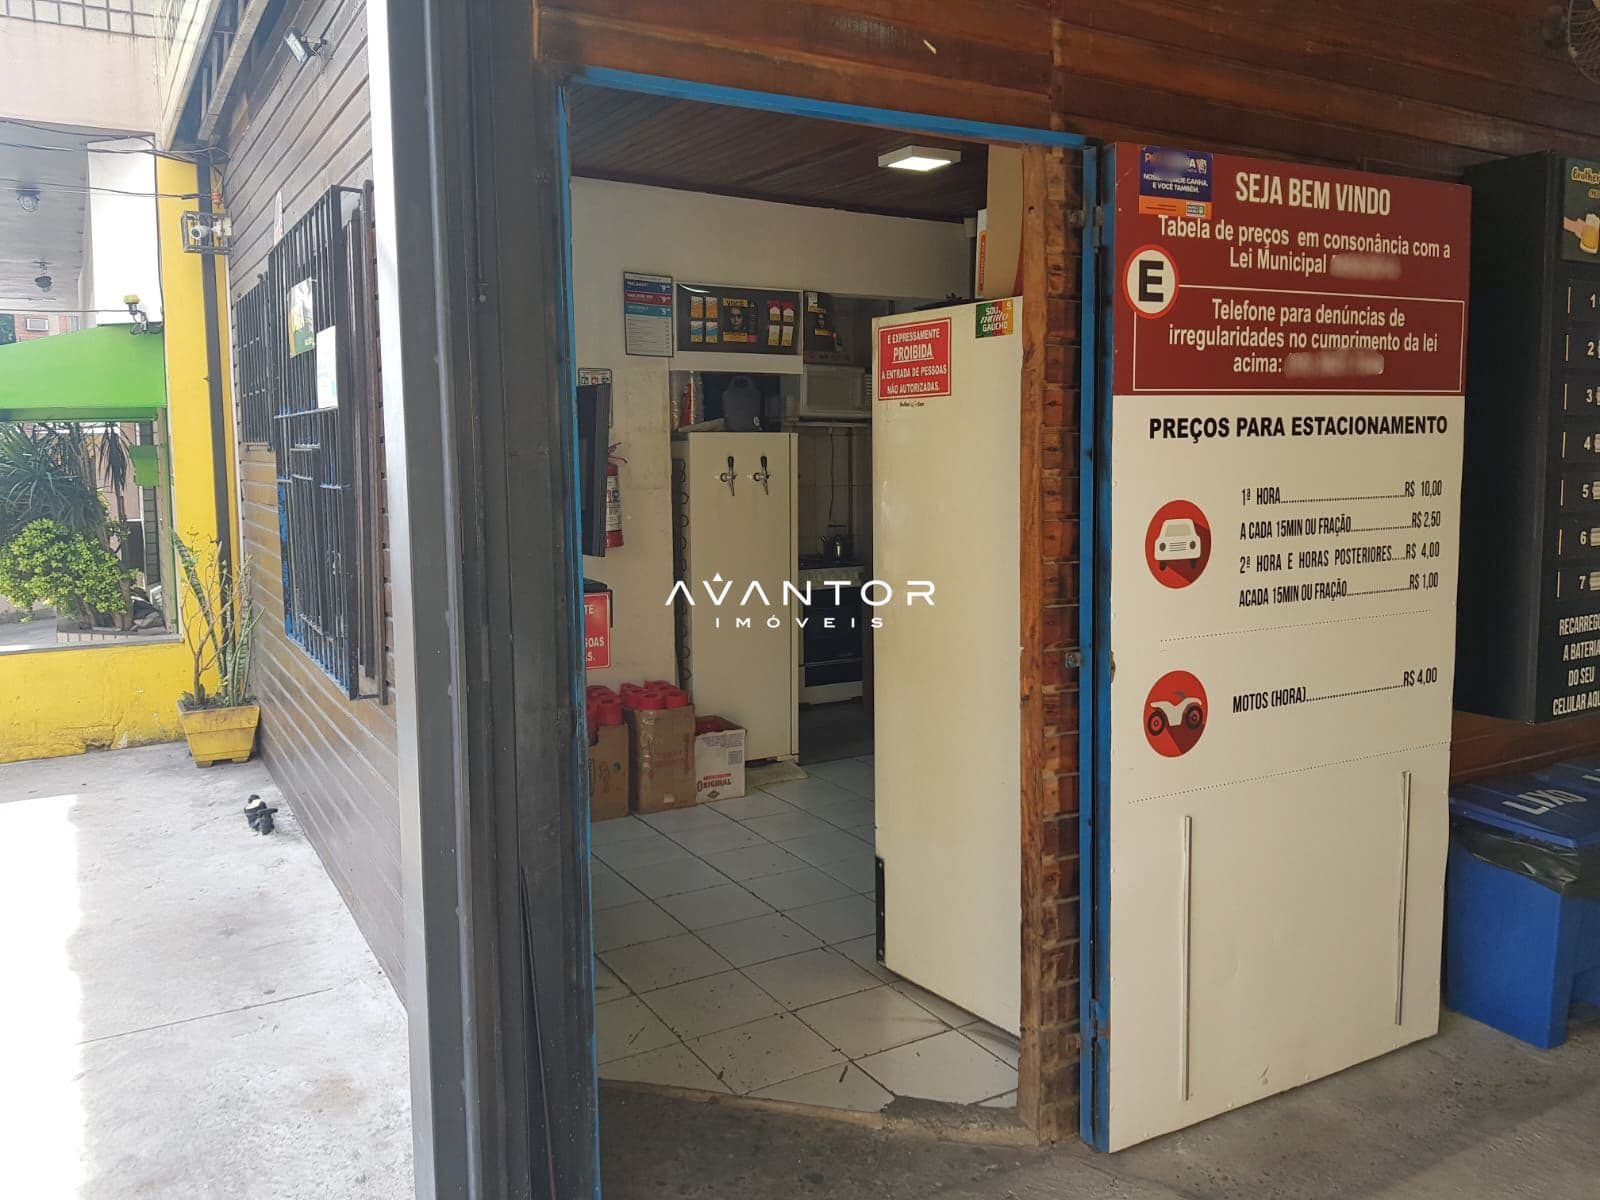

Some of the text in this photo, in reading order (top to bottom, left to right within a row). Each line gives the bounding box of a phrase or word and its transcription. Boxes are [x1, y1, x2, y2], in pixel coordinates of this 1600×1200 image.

[1235, 171, 1391, 215] SEJA BEM VINDO
[1158, 214, 1451, 259] Tabela de preços em consonância com a
[1230, 246, 1253, 268] Lei
[1257, 248, 1327, 277] Municipal
[1138, 260, 1165, 303] E
[1212, 298, 1406, 327] Telefone para denúncias de
[892, 328, 940, 344] EXPRESSAMENTE
[1169, 323, 1438, 352] irregularidades no cumprimento da lei
[893, 343, 933, 361] PROIBIDA
[1233, 352, 1282, 373] acima:
[881, 364, 947, 380] A ENTRADA DE PESSOAS
[1149, 415, 1448, 443] PREÇOS PARA ESTACIONAMENTO
[1241, 487, 1251, 506] 1ª
[1421, 480, 1442, 499] 10,00
[1240, 522, 1246, 540] A
[1248, 521, 1273, 540] CADA
[1276, 519, 1303, 538] 15MIN
[1305, 518, 1317, 536] OU
[1423, 511, 1441, 528] 2,50
[1239, 556, 1251, 574] 2ª
[1256, 554, 1282, 572] HORA
[1287, 552, 1294, 569] E
[1298, 550, 1329, 569] HORAS
[1334, 545, 1392, 566] POSTERIORES
[1421, 541, 1440, 559] 4,00
[1273, 585, 1300, 604] 15MIN
[1301, 583, 1313, 601] OU
[1422, 572, 1439, 590] 1,00
[1562, 644, 1569, 662] A
[1232, 692, 1269, 713] MOTOS
[1416, 667, 1438, 686] 4,00
[1568, 666, 1595, 687] DO SEU
[1552, 693, 1586, 716] CELULAR
